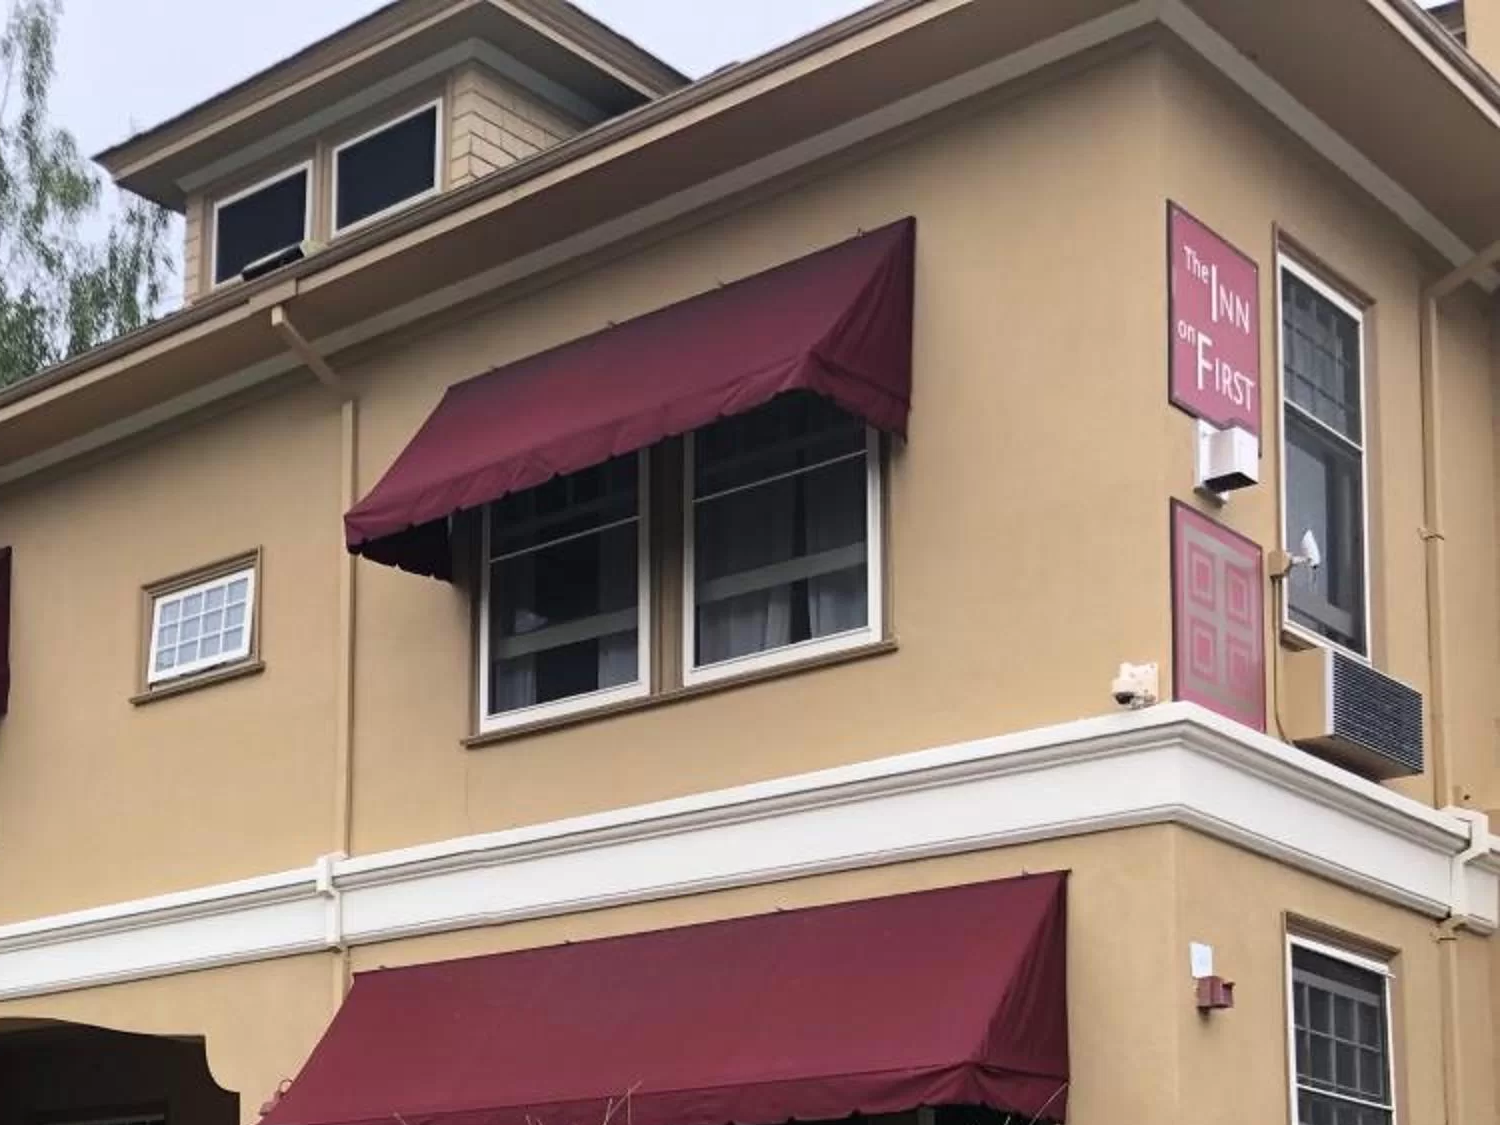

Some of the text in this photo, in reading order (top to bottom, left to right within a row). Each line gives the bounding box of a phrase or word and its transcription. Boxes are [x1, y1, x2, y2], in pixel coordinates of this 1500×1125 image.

[1182, 245, 1250, 335] The INN
[1177, 319, 1255, 412] on FIRST
